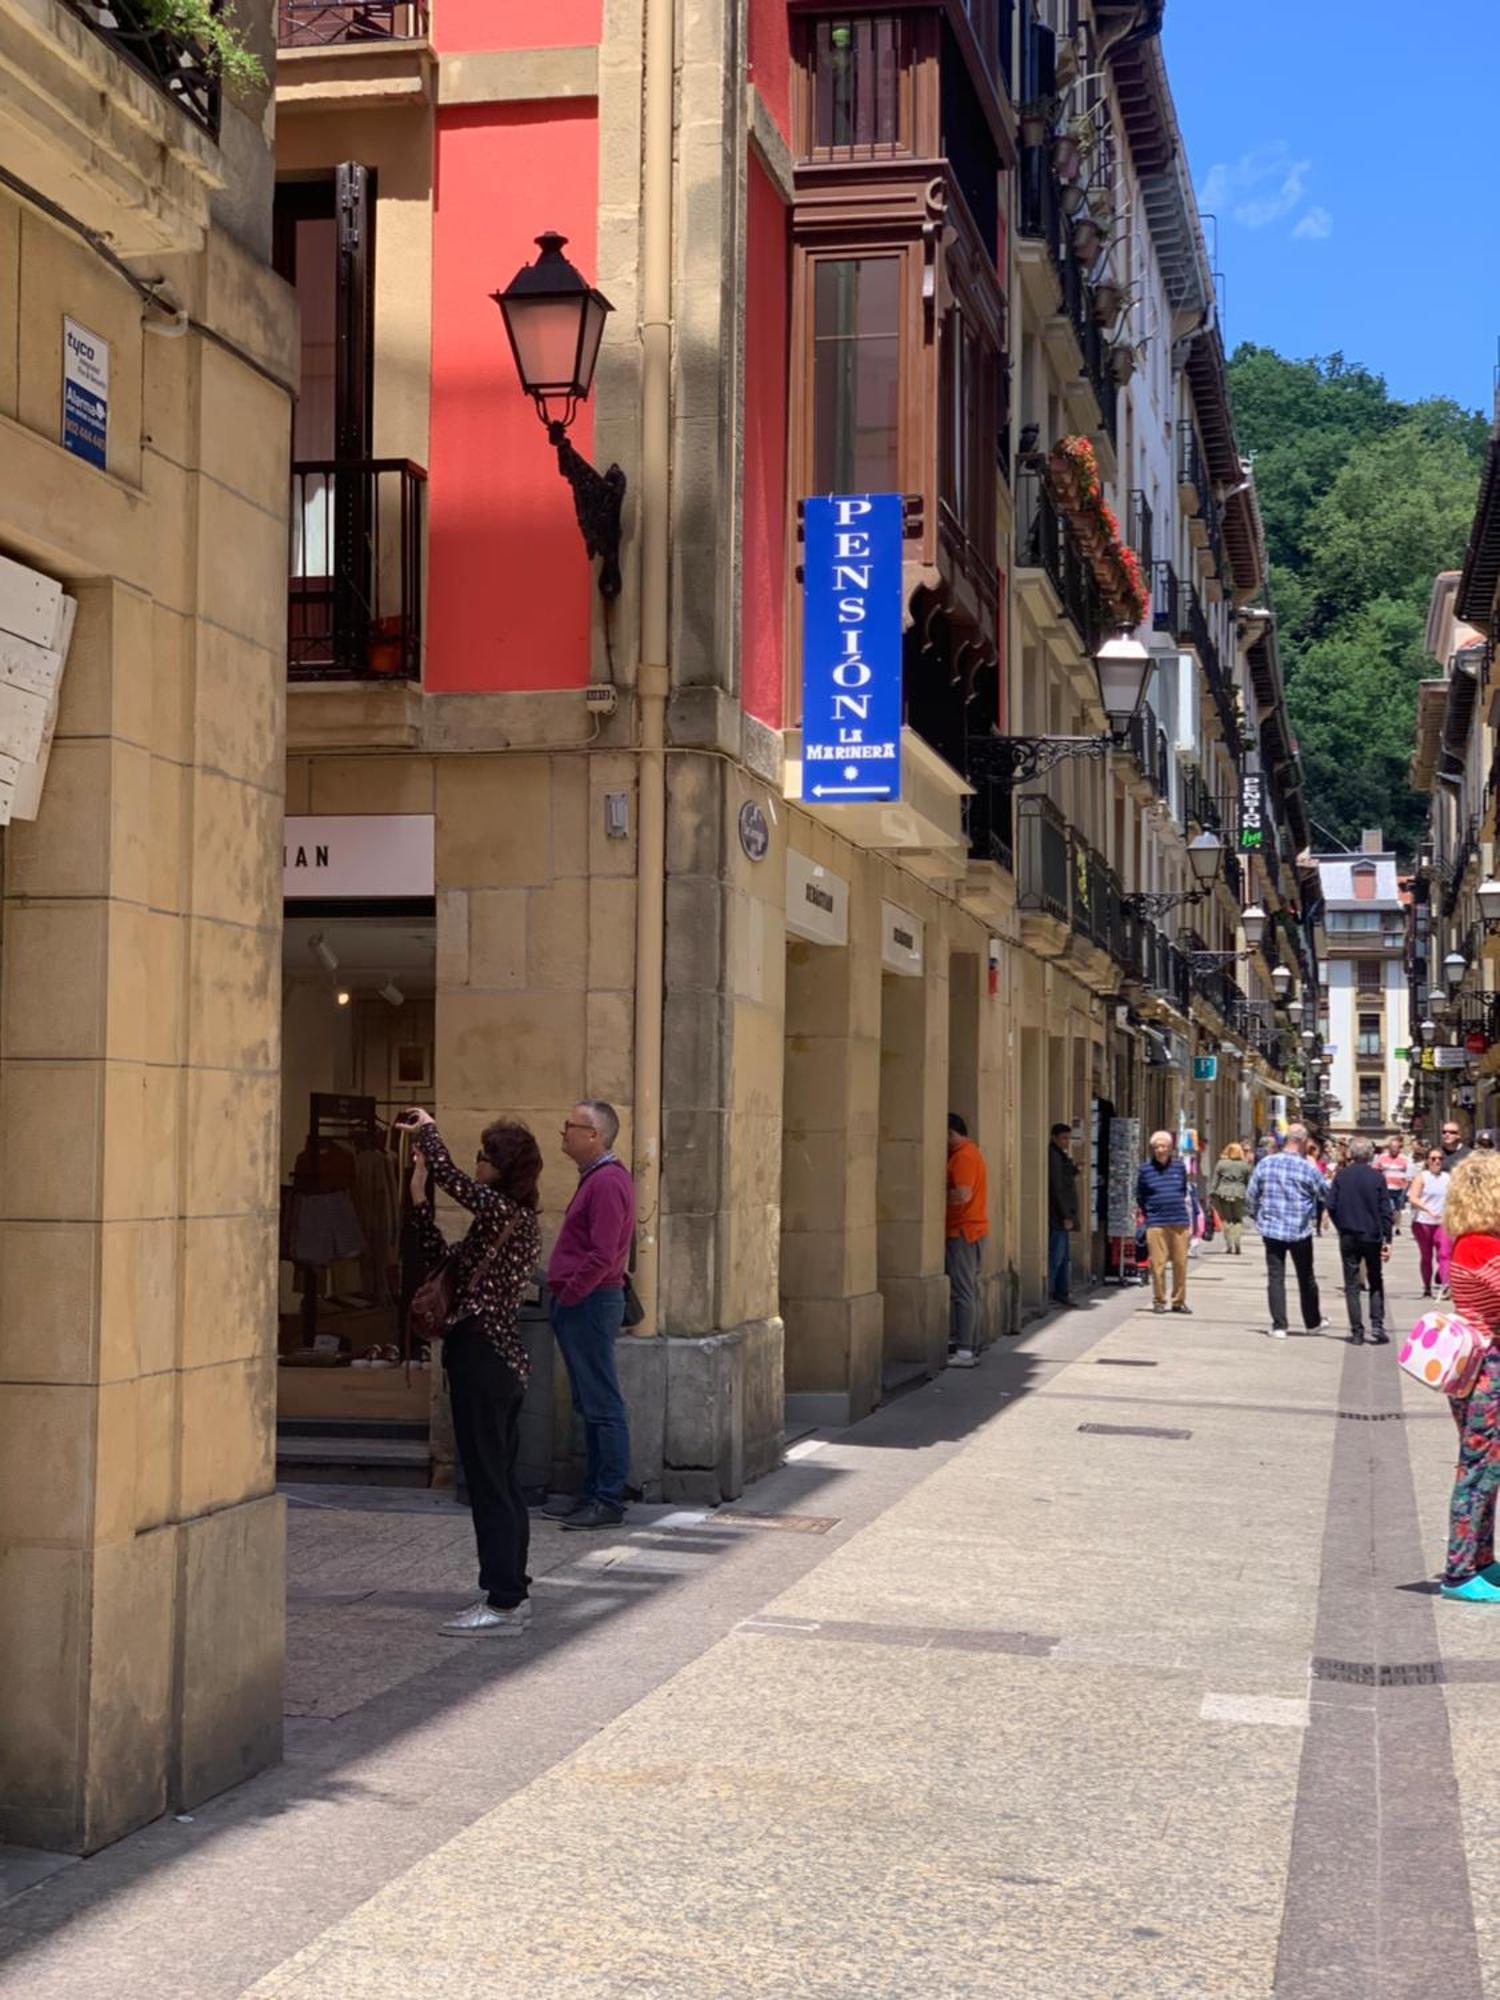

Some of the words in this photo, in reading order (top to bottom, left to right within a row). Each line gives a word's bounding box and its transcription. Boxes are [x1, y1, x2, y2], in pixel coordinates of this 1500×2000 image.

[67, 332, 95, 361] tyco
[830, 500, 873, 720] PENSIÓN
[839, 728, 863, 743] LA
[806, 743, 896, 761] MARINERA
